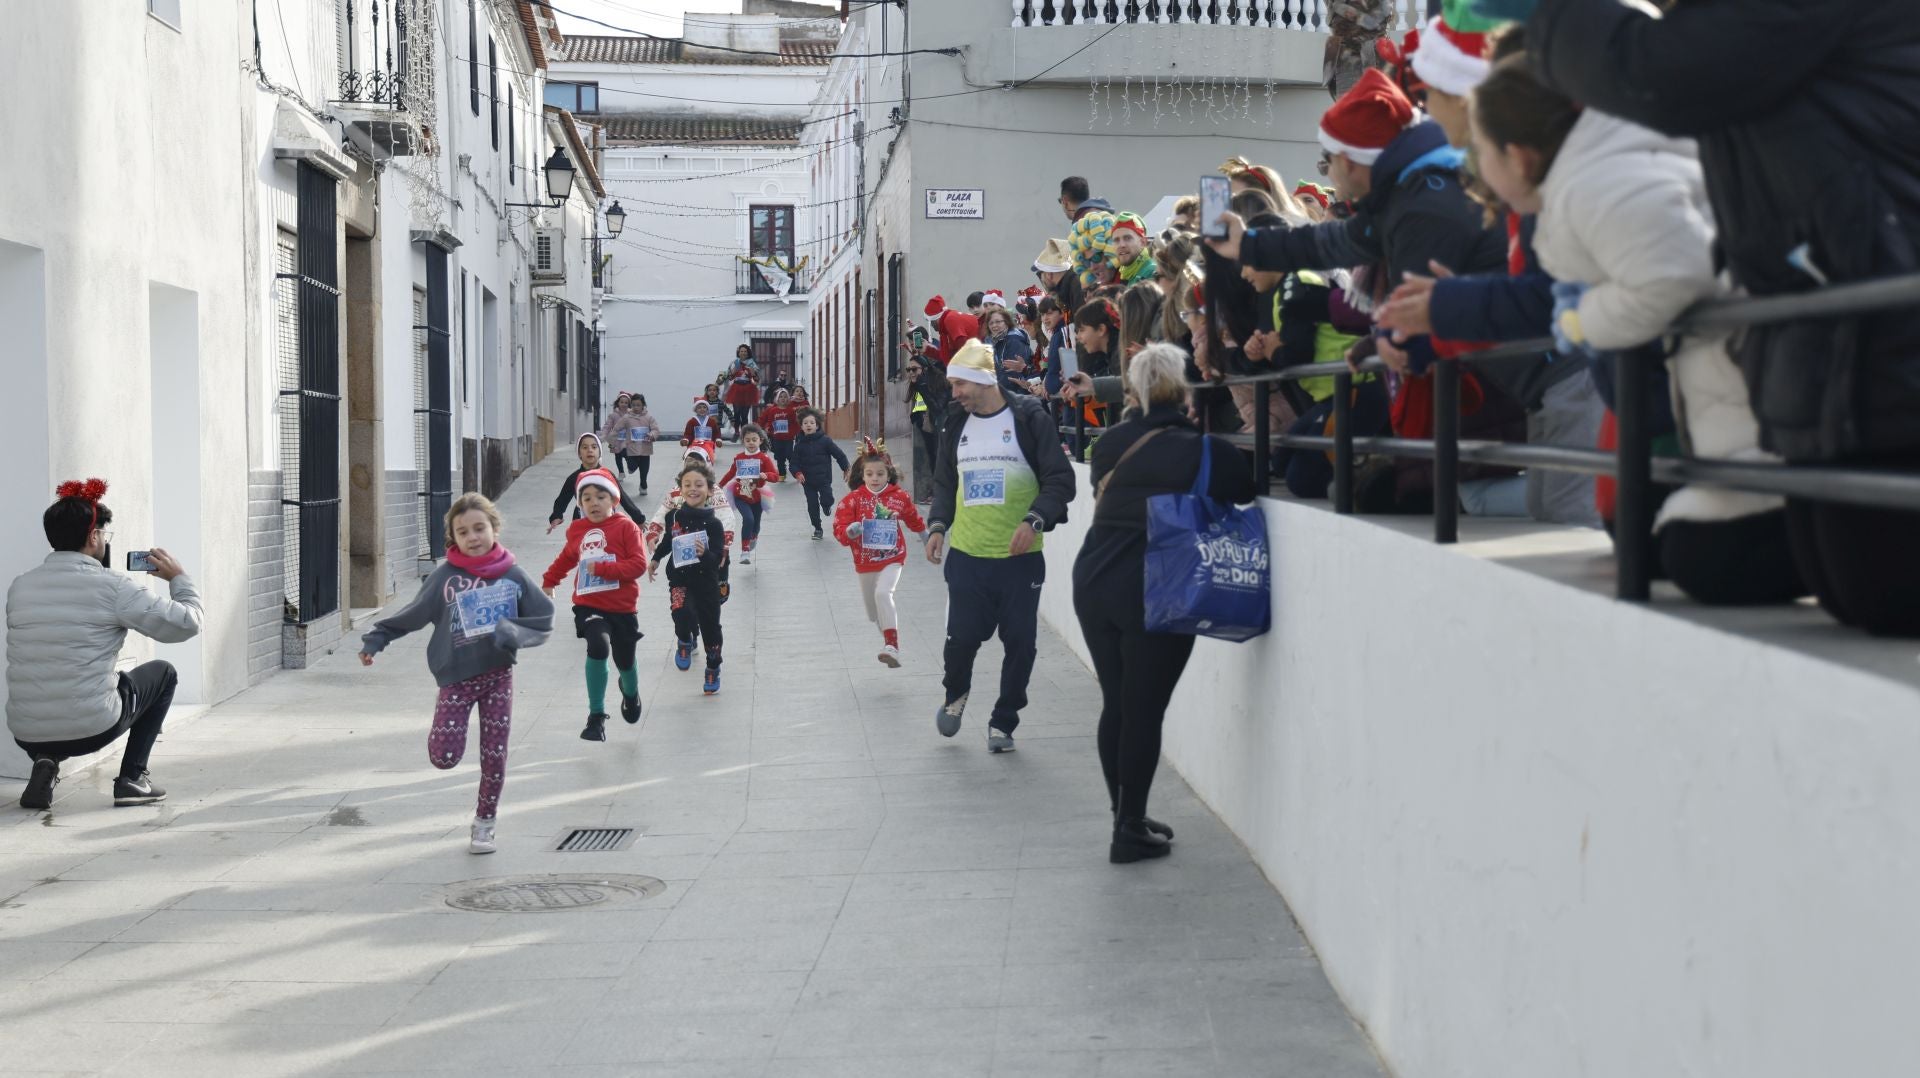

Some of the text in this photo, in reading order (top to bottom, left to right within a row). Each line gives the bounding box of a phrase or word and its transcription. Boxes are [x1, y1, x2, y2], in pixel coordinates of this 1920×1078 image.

[946, 193, 971, 201] PLAZA
[969, 483, 996, 499] 88
[475, 603, 510, 626] 38
